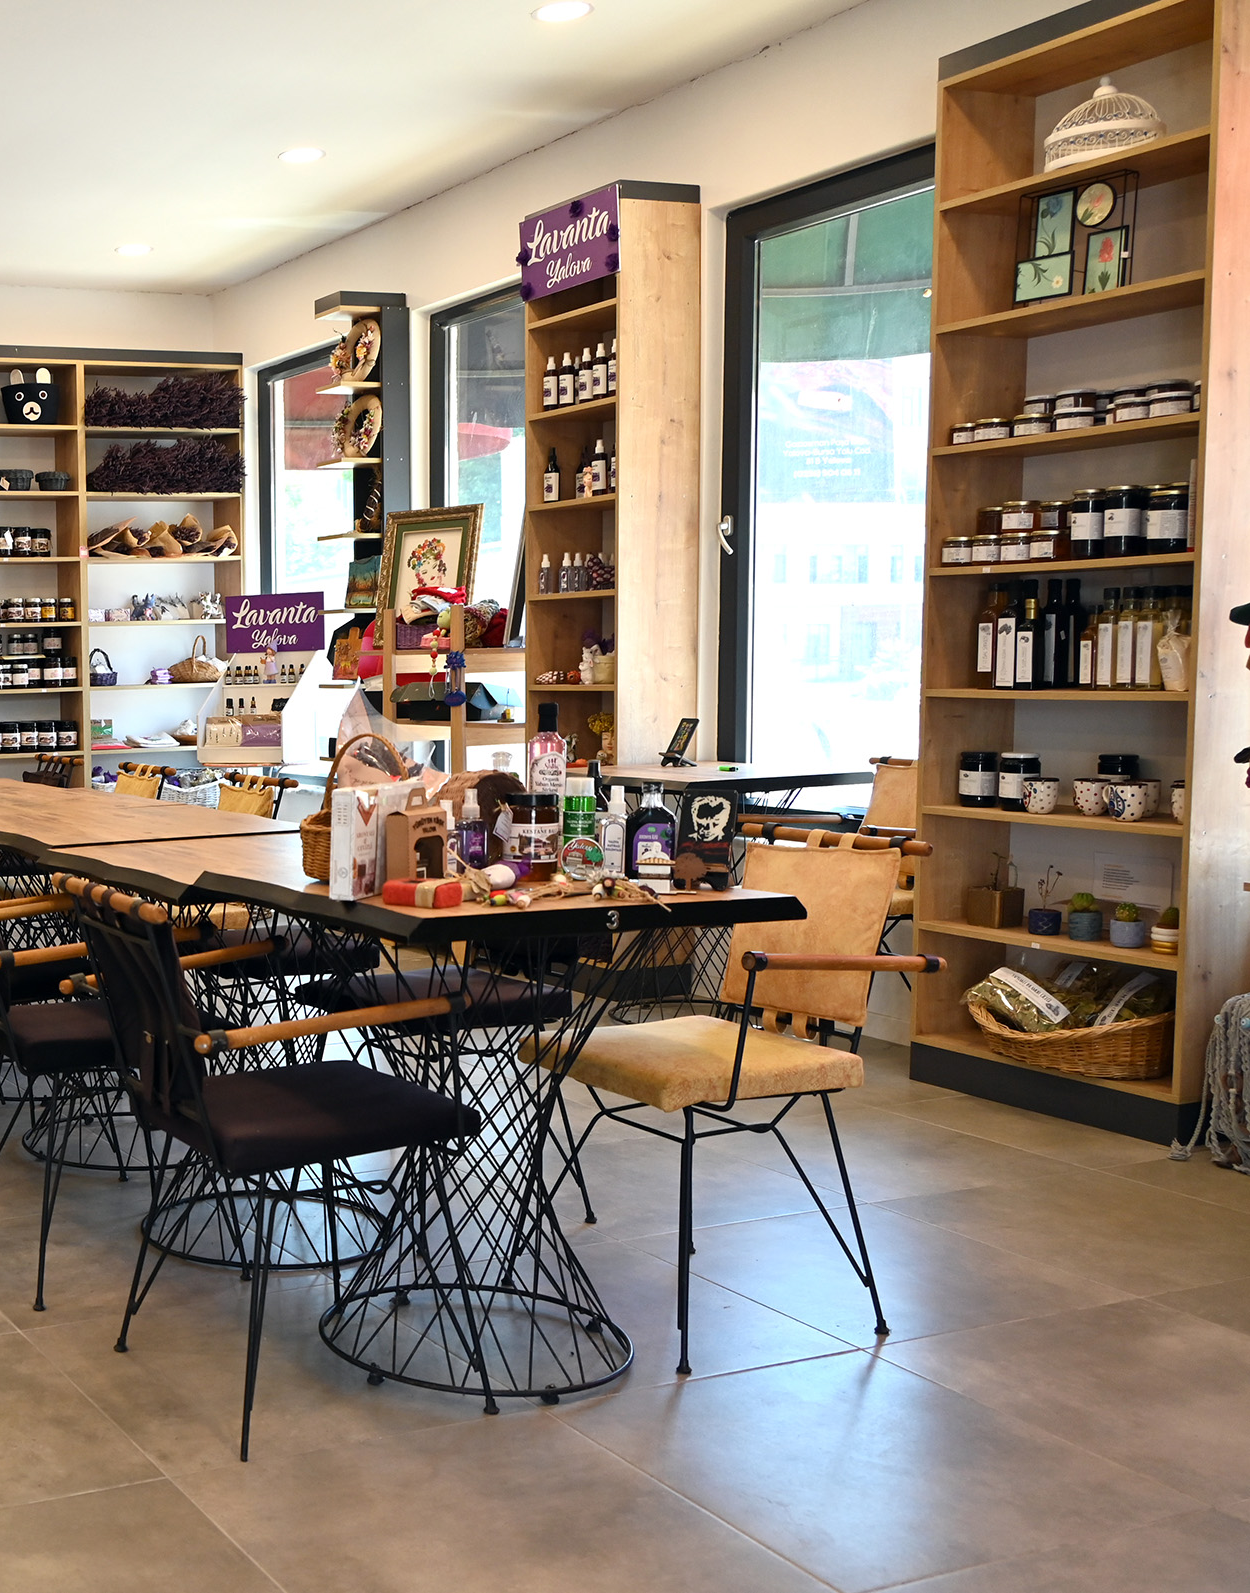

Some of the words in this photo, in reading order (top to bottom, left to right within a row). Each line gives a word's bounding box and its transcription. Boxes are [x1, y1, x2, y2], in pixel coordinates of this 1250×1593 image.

[526, 207, 611, 266] Lavanta
[546, 253, 592, 288] Yalova
[232, 598, 319, 630] Lavanta
[251, 628, 299, 649] Yalova
